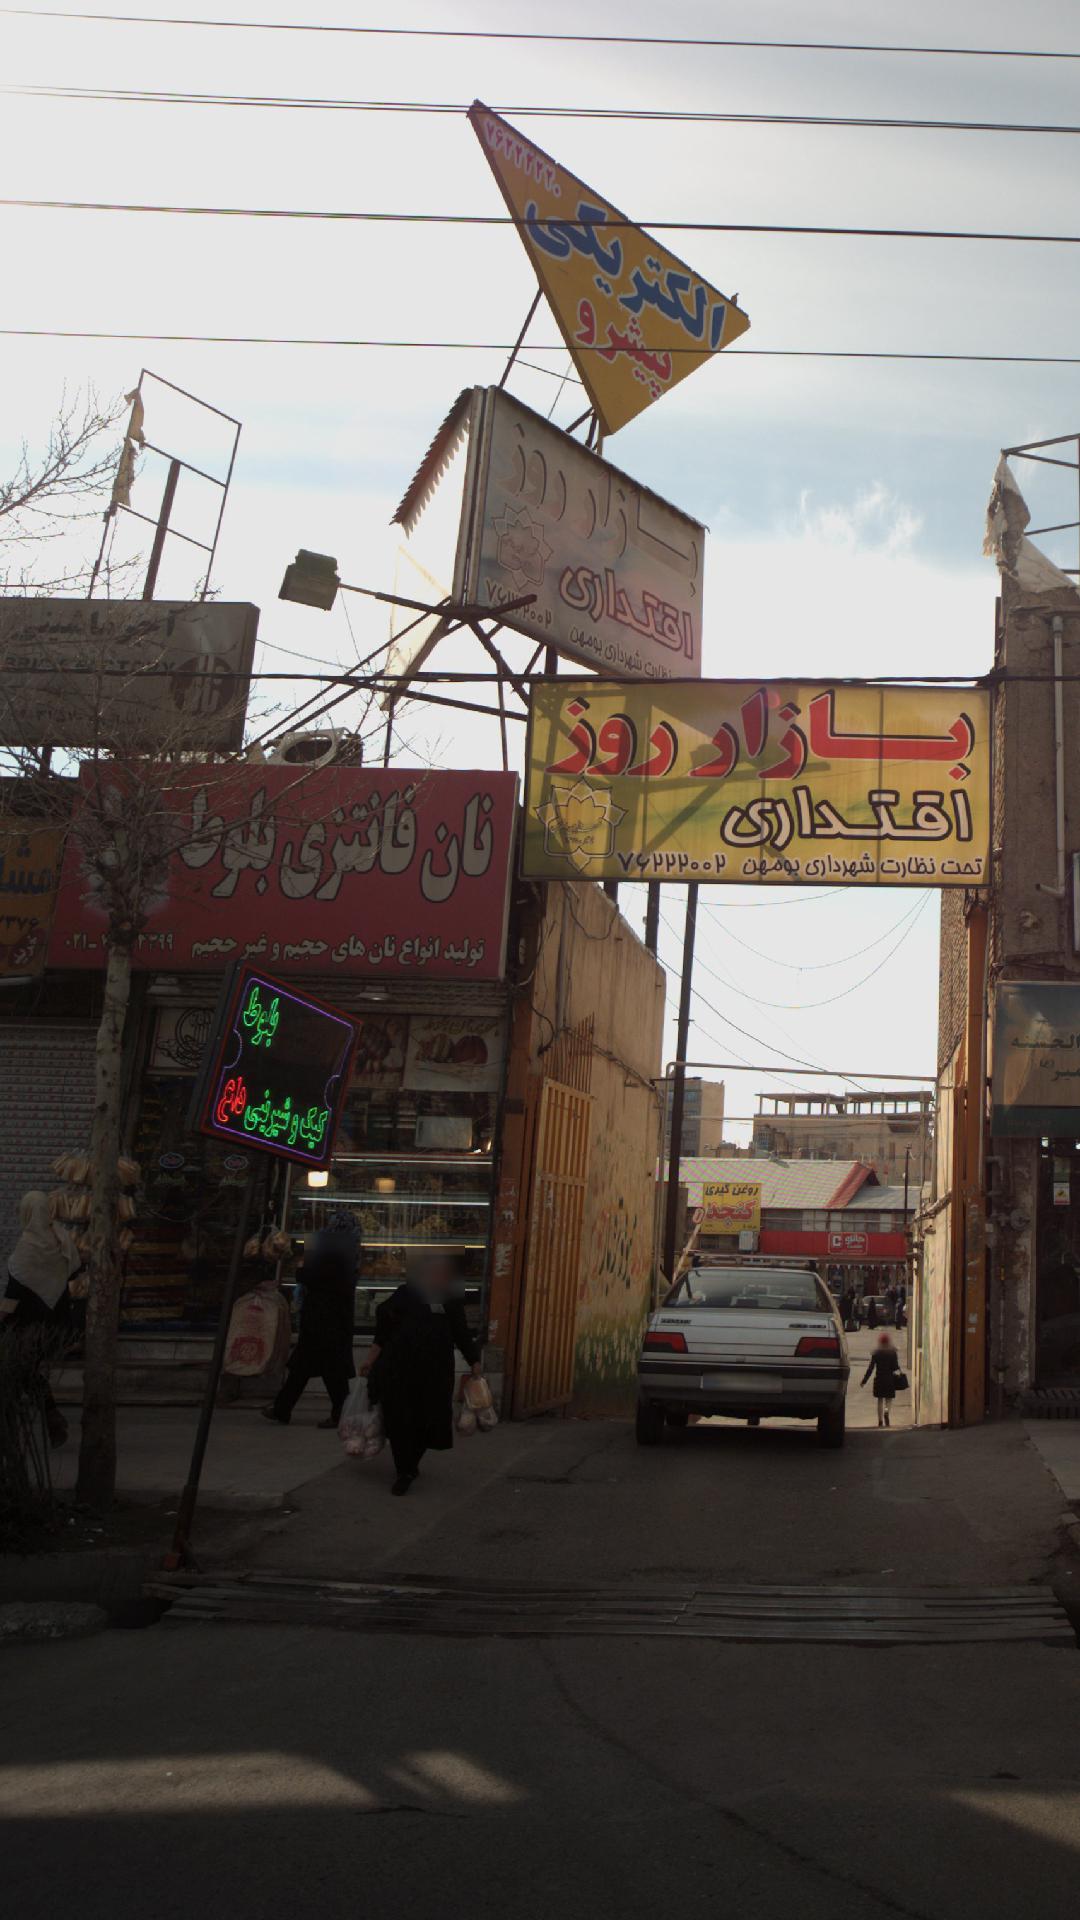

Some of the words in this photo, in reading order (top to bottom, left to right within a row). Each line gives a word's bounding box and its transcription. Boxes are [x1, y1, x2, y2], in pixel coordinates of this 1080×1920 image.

[525, 201, 726, 350] الکتریکی
[575, 299, 673, 399] پیشرو
[559, 565, 694, 660] اقتداری
[604, 641, 643, 671] شهرداری
[544, 696, 679, 777] روز
[688, 688, 976, 781] بازار
[720, 785, 973, 852] اقتداری
[176, 787, 277, 898] بلوط
[279, 785, 418, 901] فانتزی
[420, 792, 495, 903] نان
[617, 851, 727, 876] ۷۶۲۲۲۰۰۲
[742, 855, 801, 877] بومهن
[805, 852, 876, 878] شهرداری
[880, 854, 936, 876] نظارت
[940, 856, 982, 877] تحت
[191, 932, 238, 959] حجیم
[241, 935, 268, 961] غیر
[269, 943, 281, 961] و
[283, 938, 330, 962] حجیم
[332, 937, 366, 963] های
[368, 934, 397, 965] نان
[398, 934, 440, 965] انواع
[445, 939, 485, 967] تولید
[243, 986, 280, 1047] بلوط
[243, 1088, 291, 1138] شیرینی
[731, 1184, 760, 1197] روغن
[706, 1199, 759, 1227] کنجد
